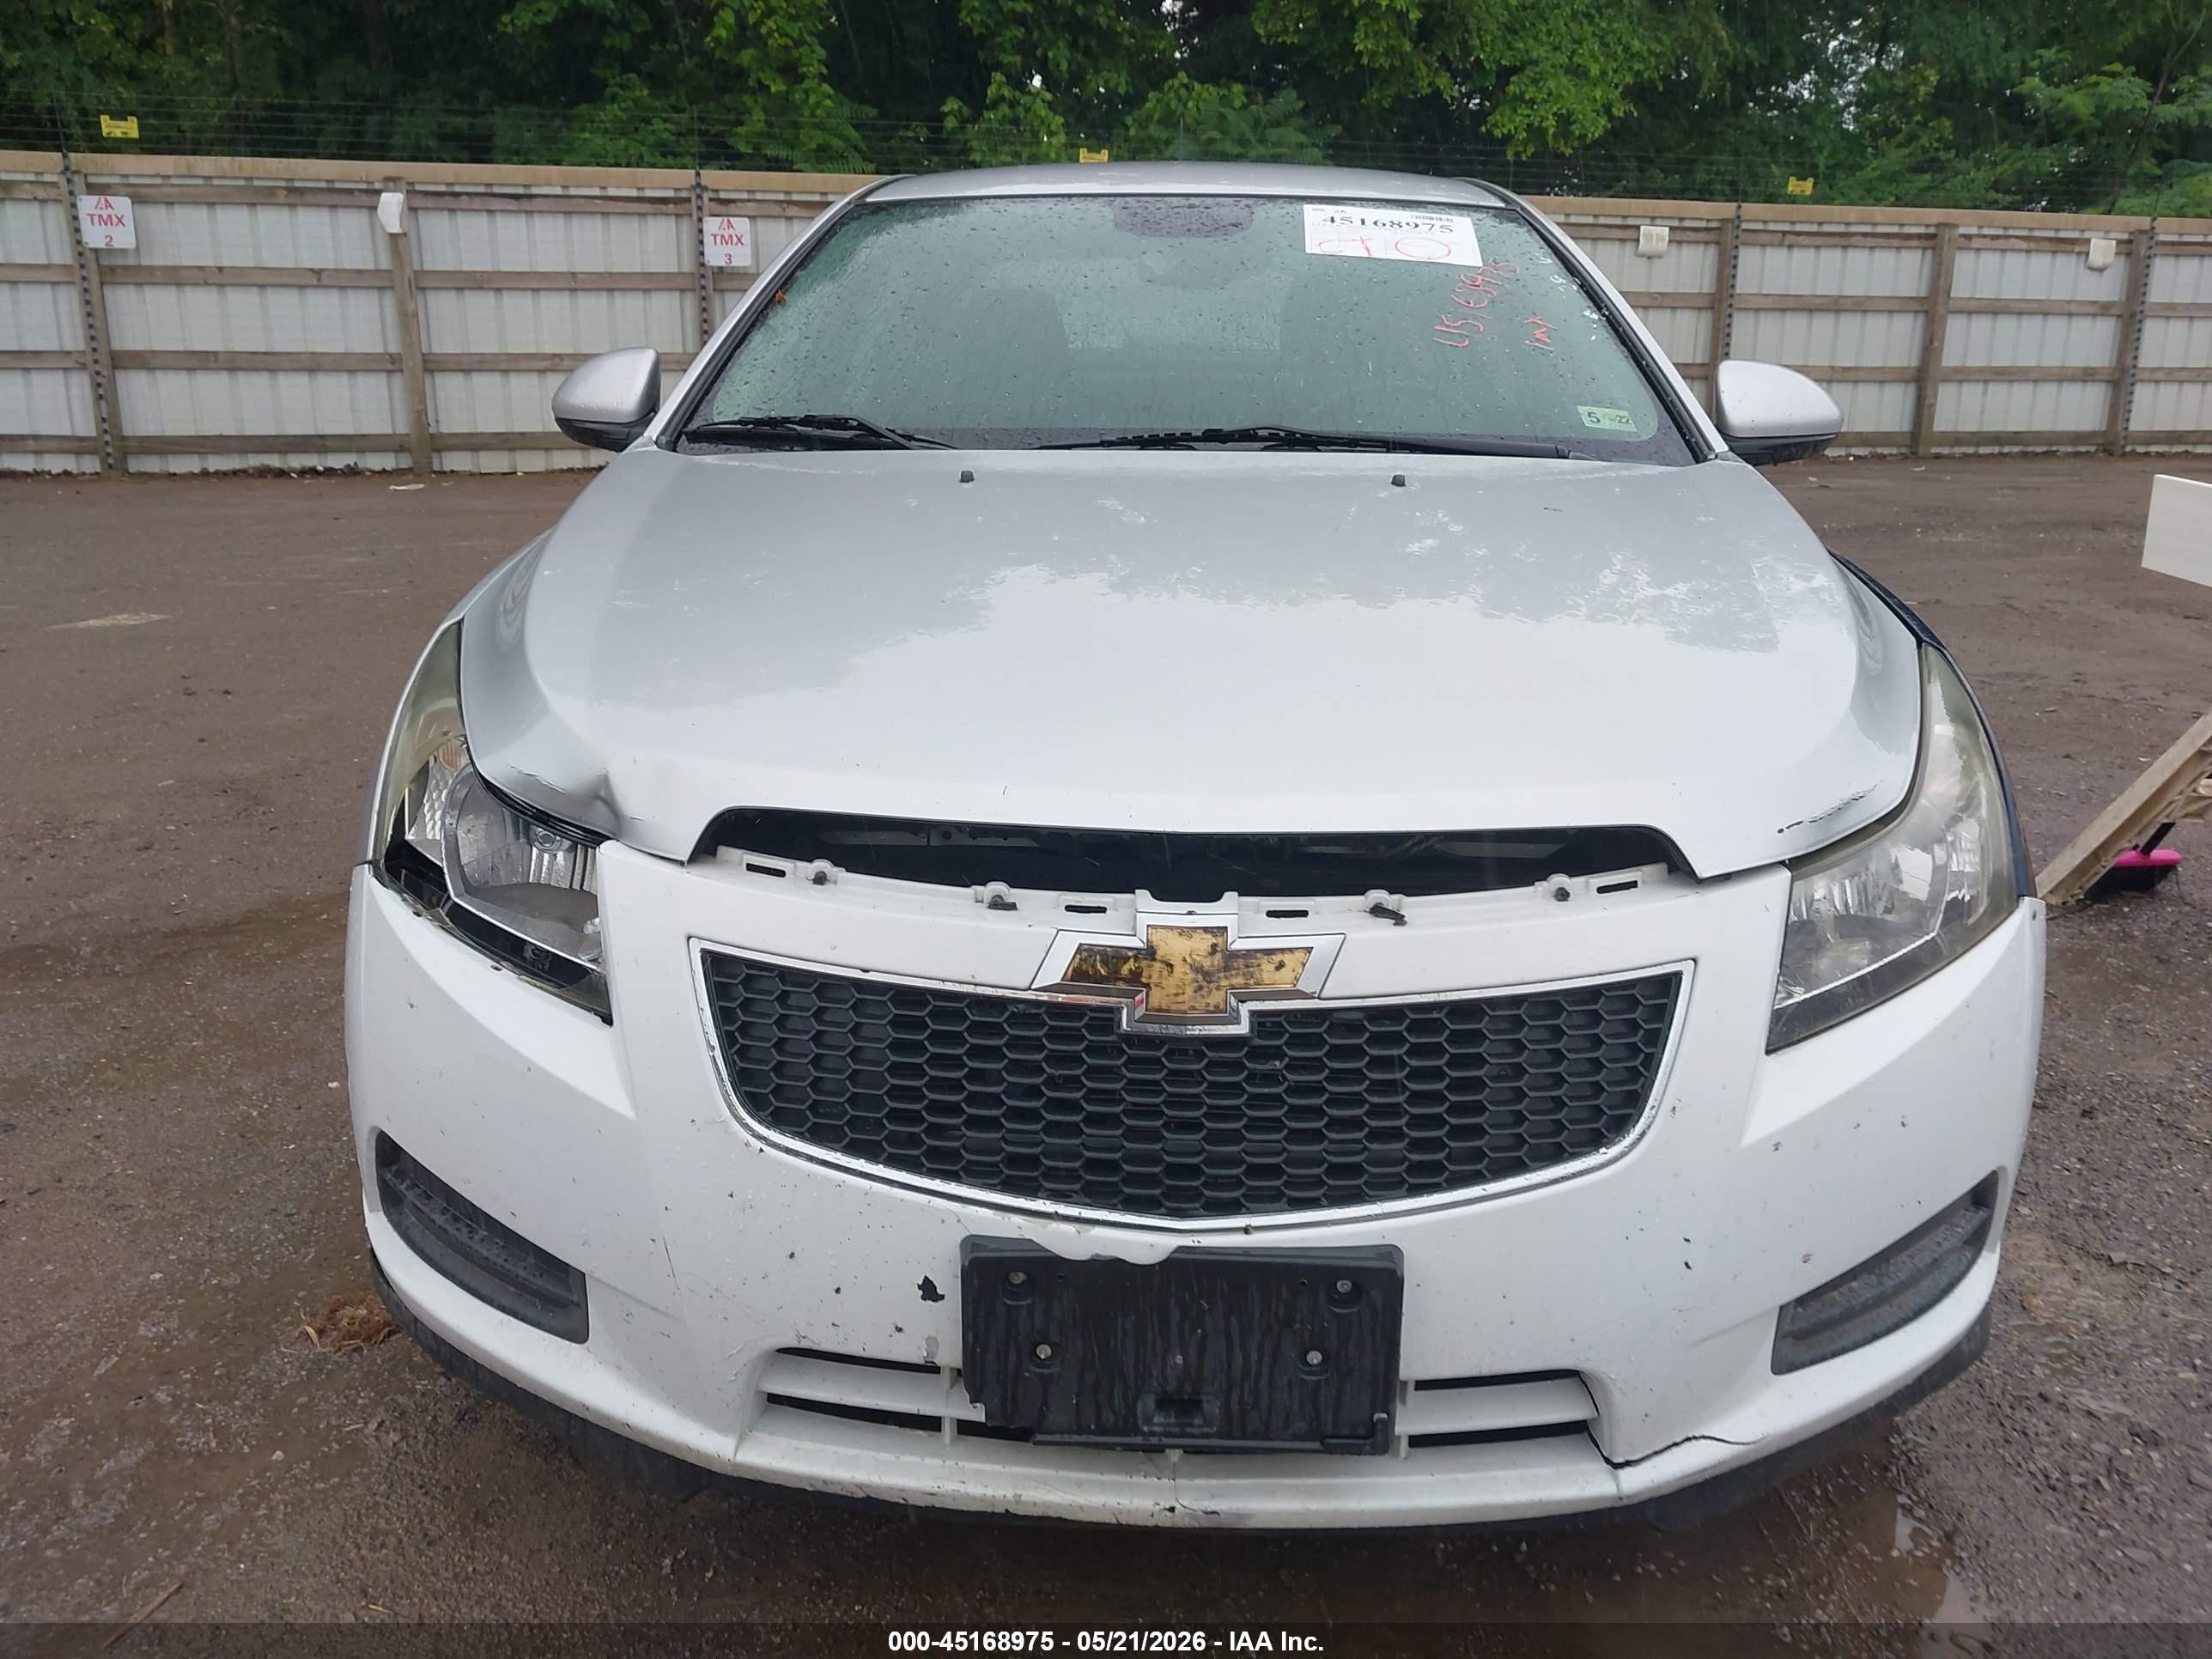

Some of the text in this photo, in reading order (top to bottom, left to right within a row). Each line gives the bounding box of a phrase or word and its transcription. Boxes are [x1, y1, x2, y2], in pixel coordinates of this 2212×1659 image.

[86, 213, 126, 228] TMX
[1322, 216, 1454, 234] 45168975
[104, 234, 114, 247] 2
[711, 233, 744, 246] TMX
[724, 253, 732, 265] 3
[1587, 411, 1632, 425] 5 22
